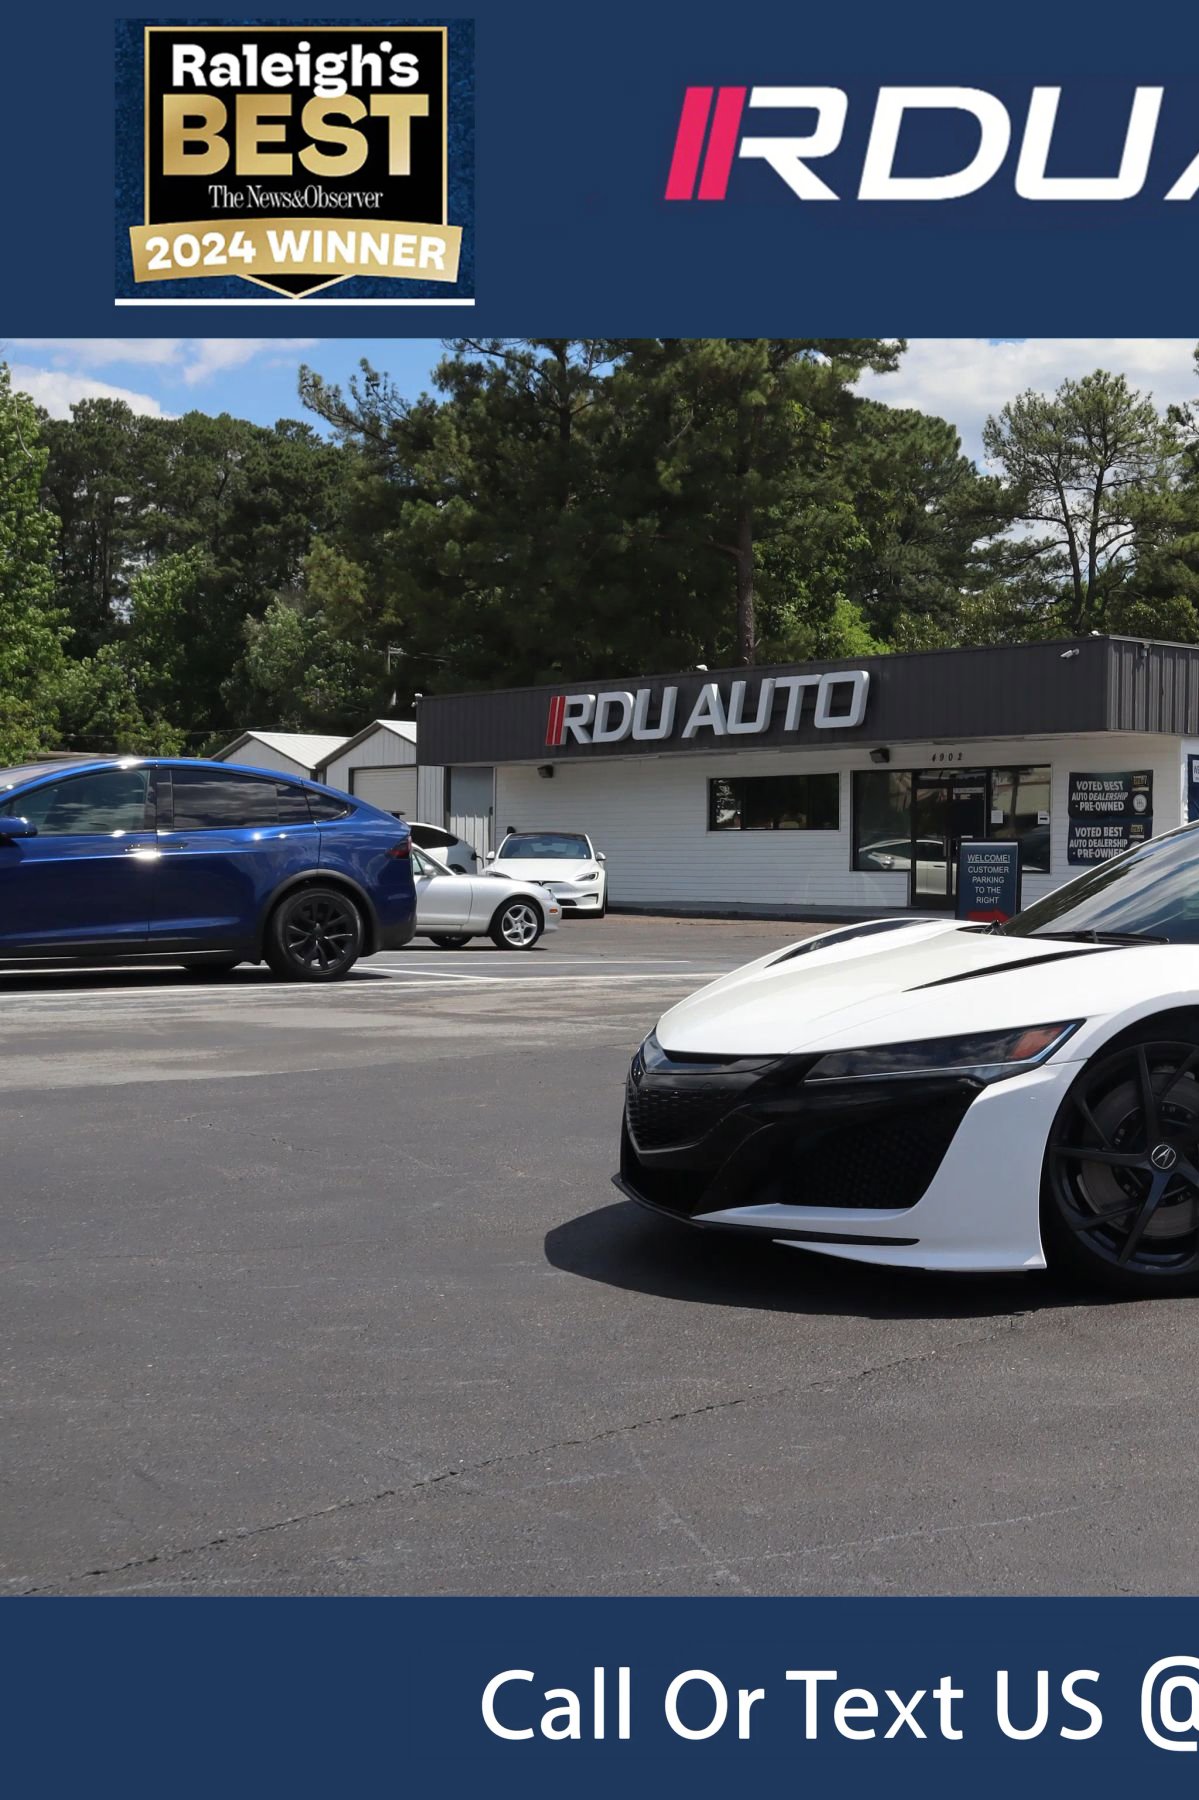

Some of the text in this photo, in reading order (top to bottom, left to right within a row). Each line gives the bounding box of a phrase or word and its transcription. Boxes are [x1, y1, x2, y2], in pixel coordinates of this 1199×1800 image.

[562, 670, 870, 744] RDU AUTO
[932, 752, 963, 762] 4902
[1076, 780, 1103, 791] VOTED
[1103, 780, 1124, 791] BEST
[1071, 791, 1129, 801] AUTO DEALERSHIP
[1079, 801, 1125, 812] PRE-OWNED
[1074, 826, 1102, 838] VOTED
[1103, 826, 1123, 837] BEST
[1069, 838, 1128, 848] AUTO DEALERSHIP
[967, 854, 1011, 864] WELCOME!
[967, 865, 1009, 874] CUSTOMER
[972, 876, 1005, 884] PARKING
[974, 886, 1002, 894] TO THE
[975, 896, 1000, 904] RIGHT
